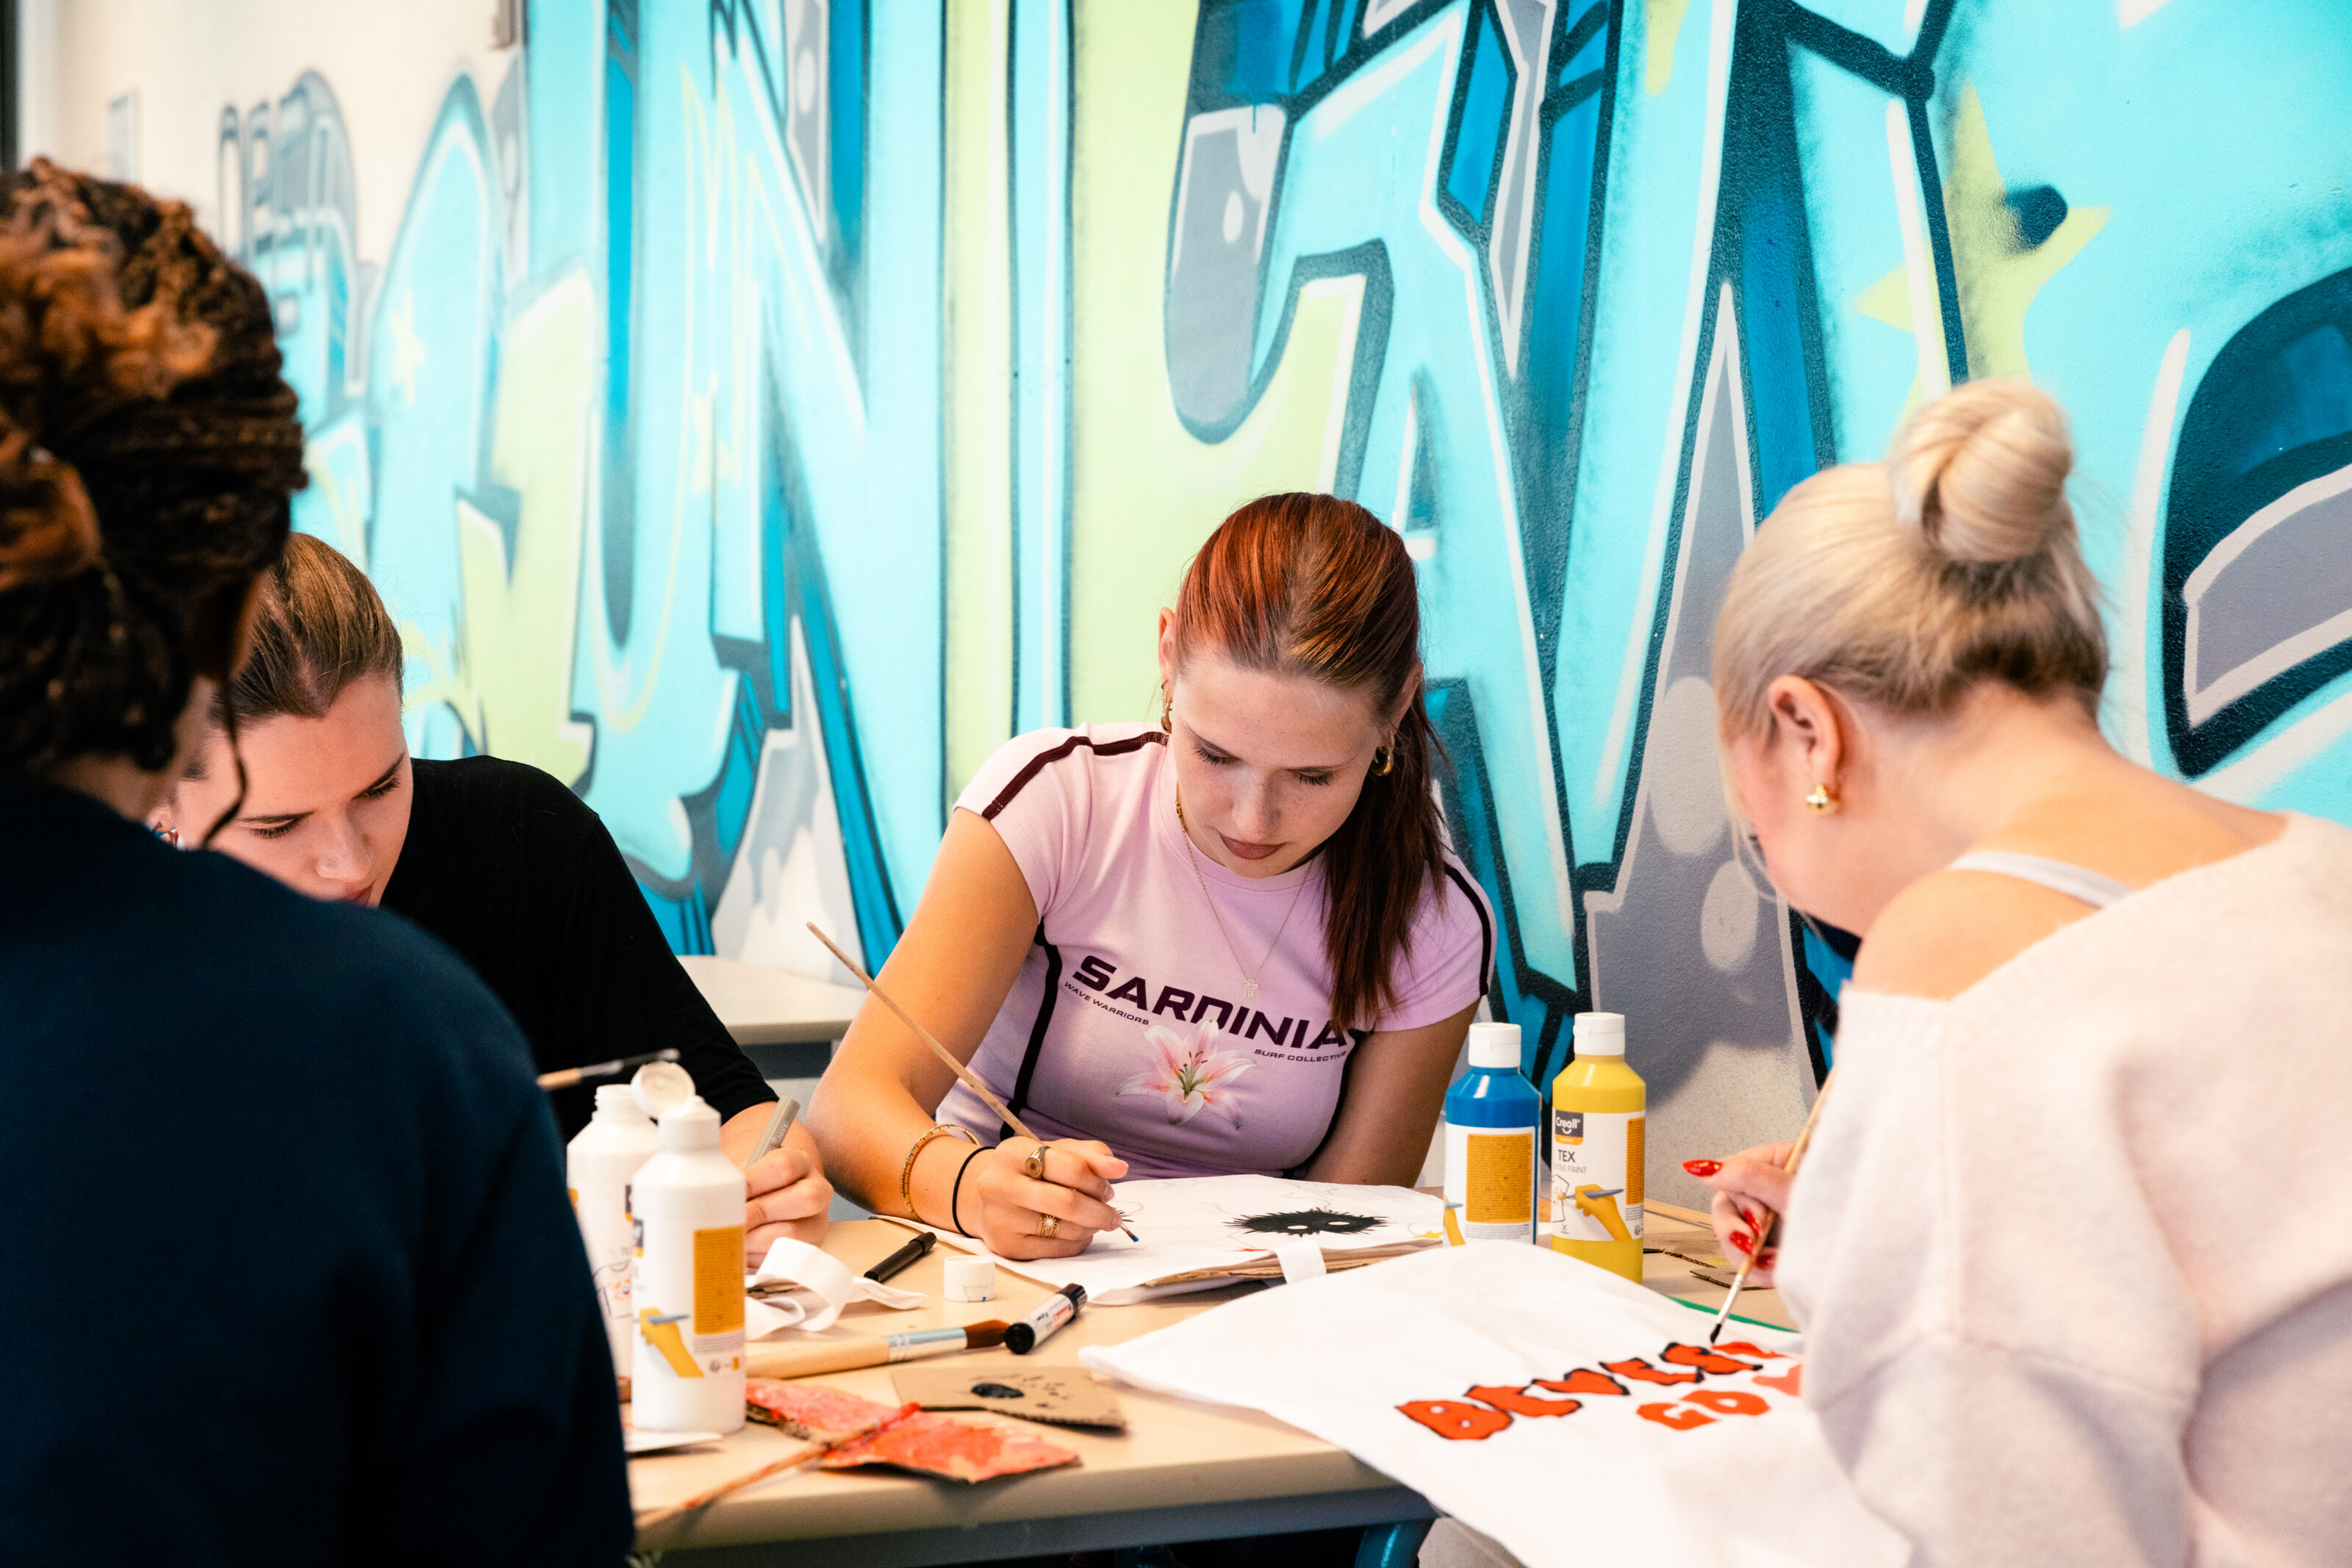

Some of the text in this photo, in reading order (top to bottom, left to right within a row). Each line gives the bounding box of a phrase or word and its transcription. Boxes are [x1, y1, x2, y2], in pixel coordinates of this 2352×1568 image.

[1064, 981, 1150, 1026] WAVE WARRIORS
[1072, 955, 1347, 1049] SARDINIA
[1254, 1049, 1286, 1059] SURF
[1558, 1149, 1576, 1162] TEX
[1567, 1165, 1588, 1173] PAINT
